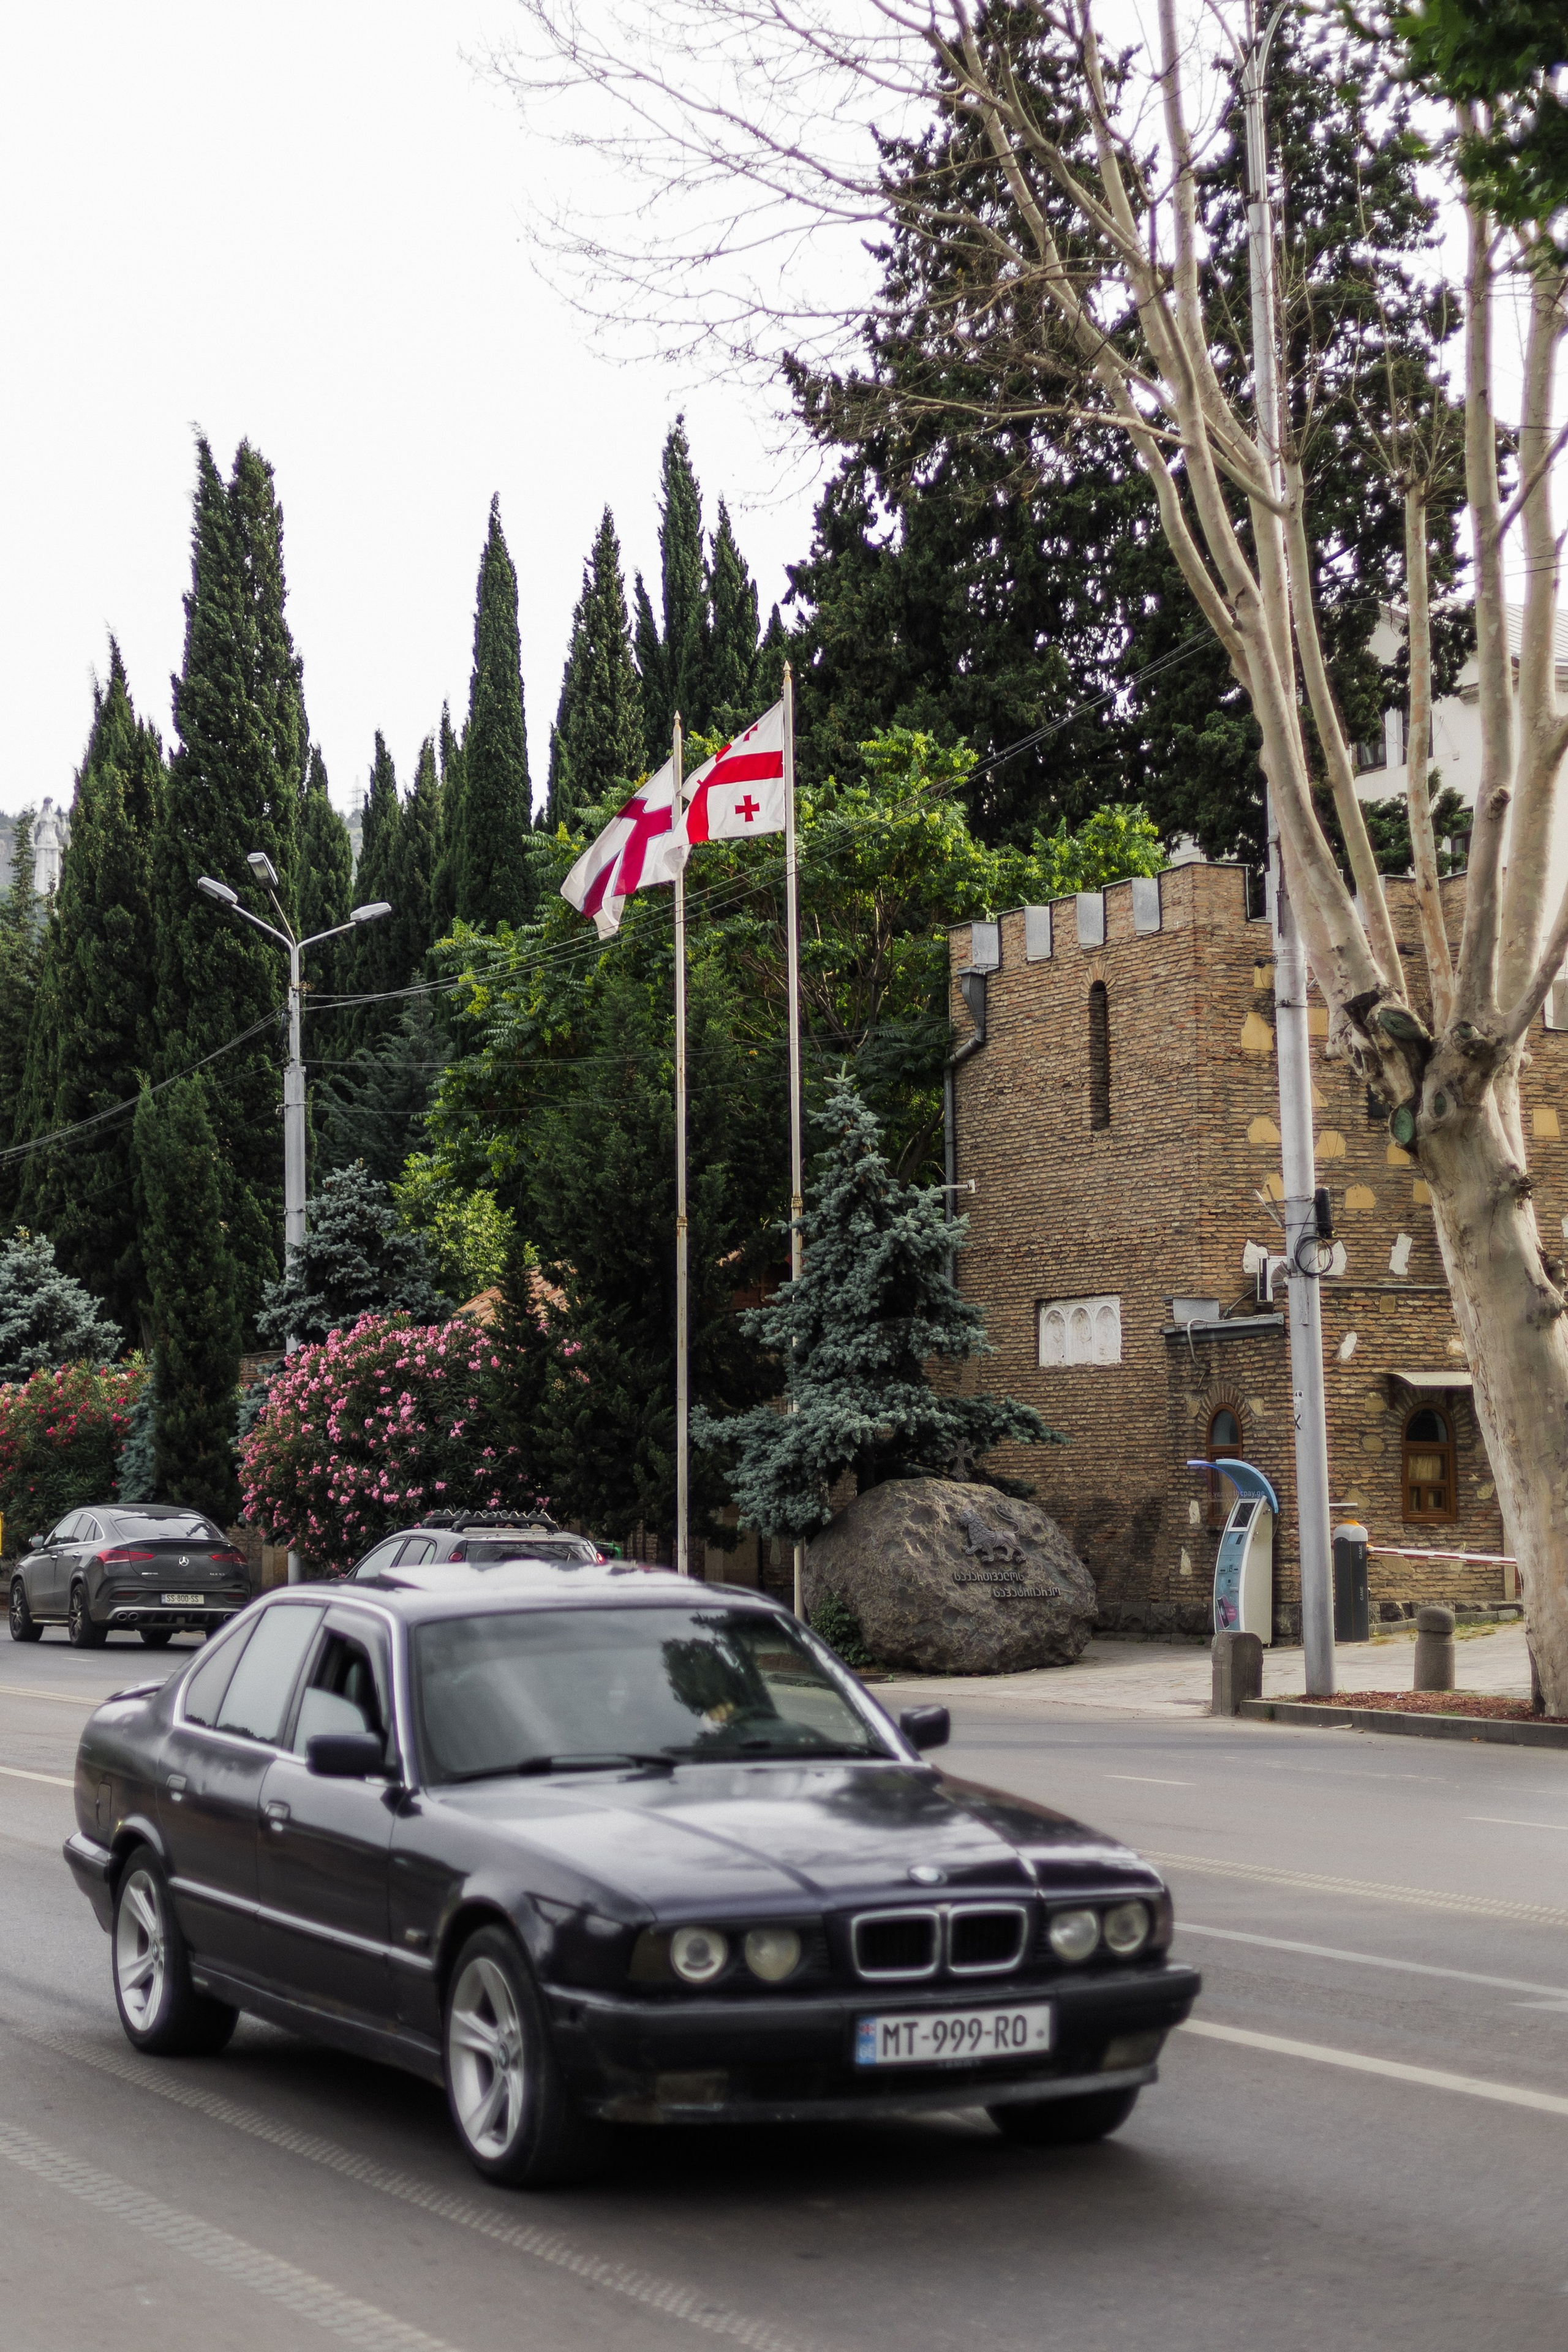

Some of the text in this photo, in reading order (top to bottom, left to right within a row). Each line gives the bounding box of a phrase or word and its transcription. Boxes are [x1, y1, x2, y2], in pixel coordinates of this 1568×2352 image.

[954, 1572, 1025, 1581] საქართველოს
[992, 1586, 1061, 1598] საპატრიარქო
[882, 2014, 1028, 2057] MT-999-RO
